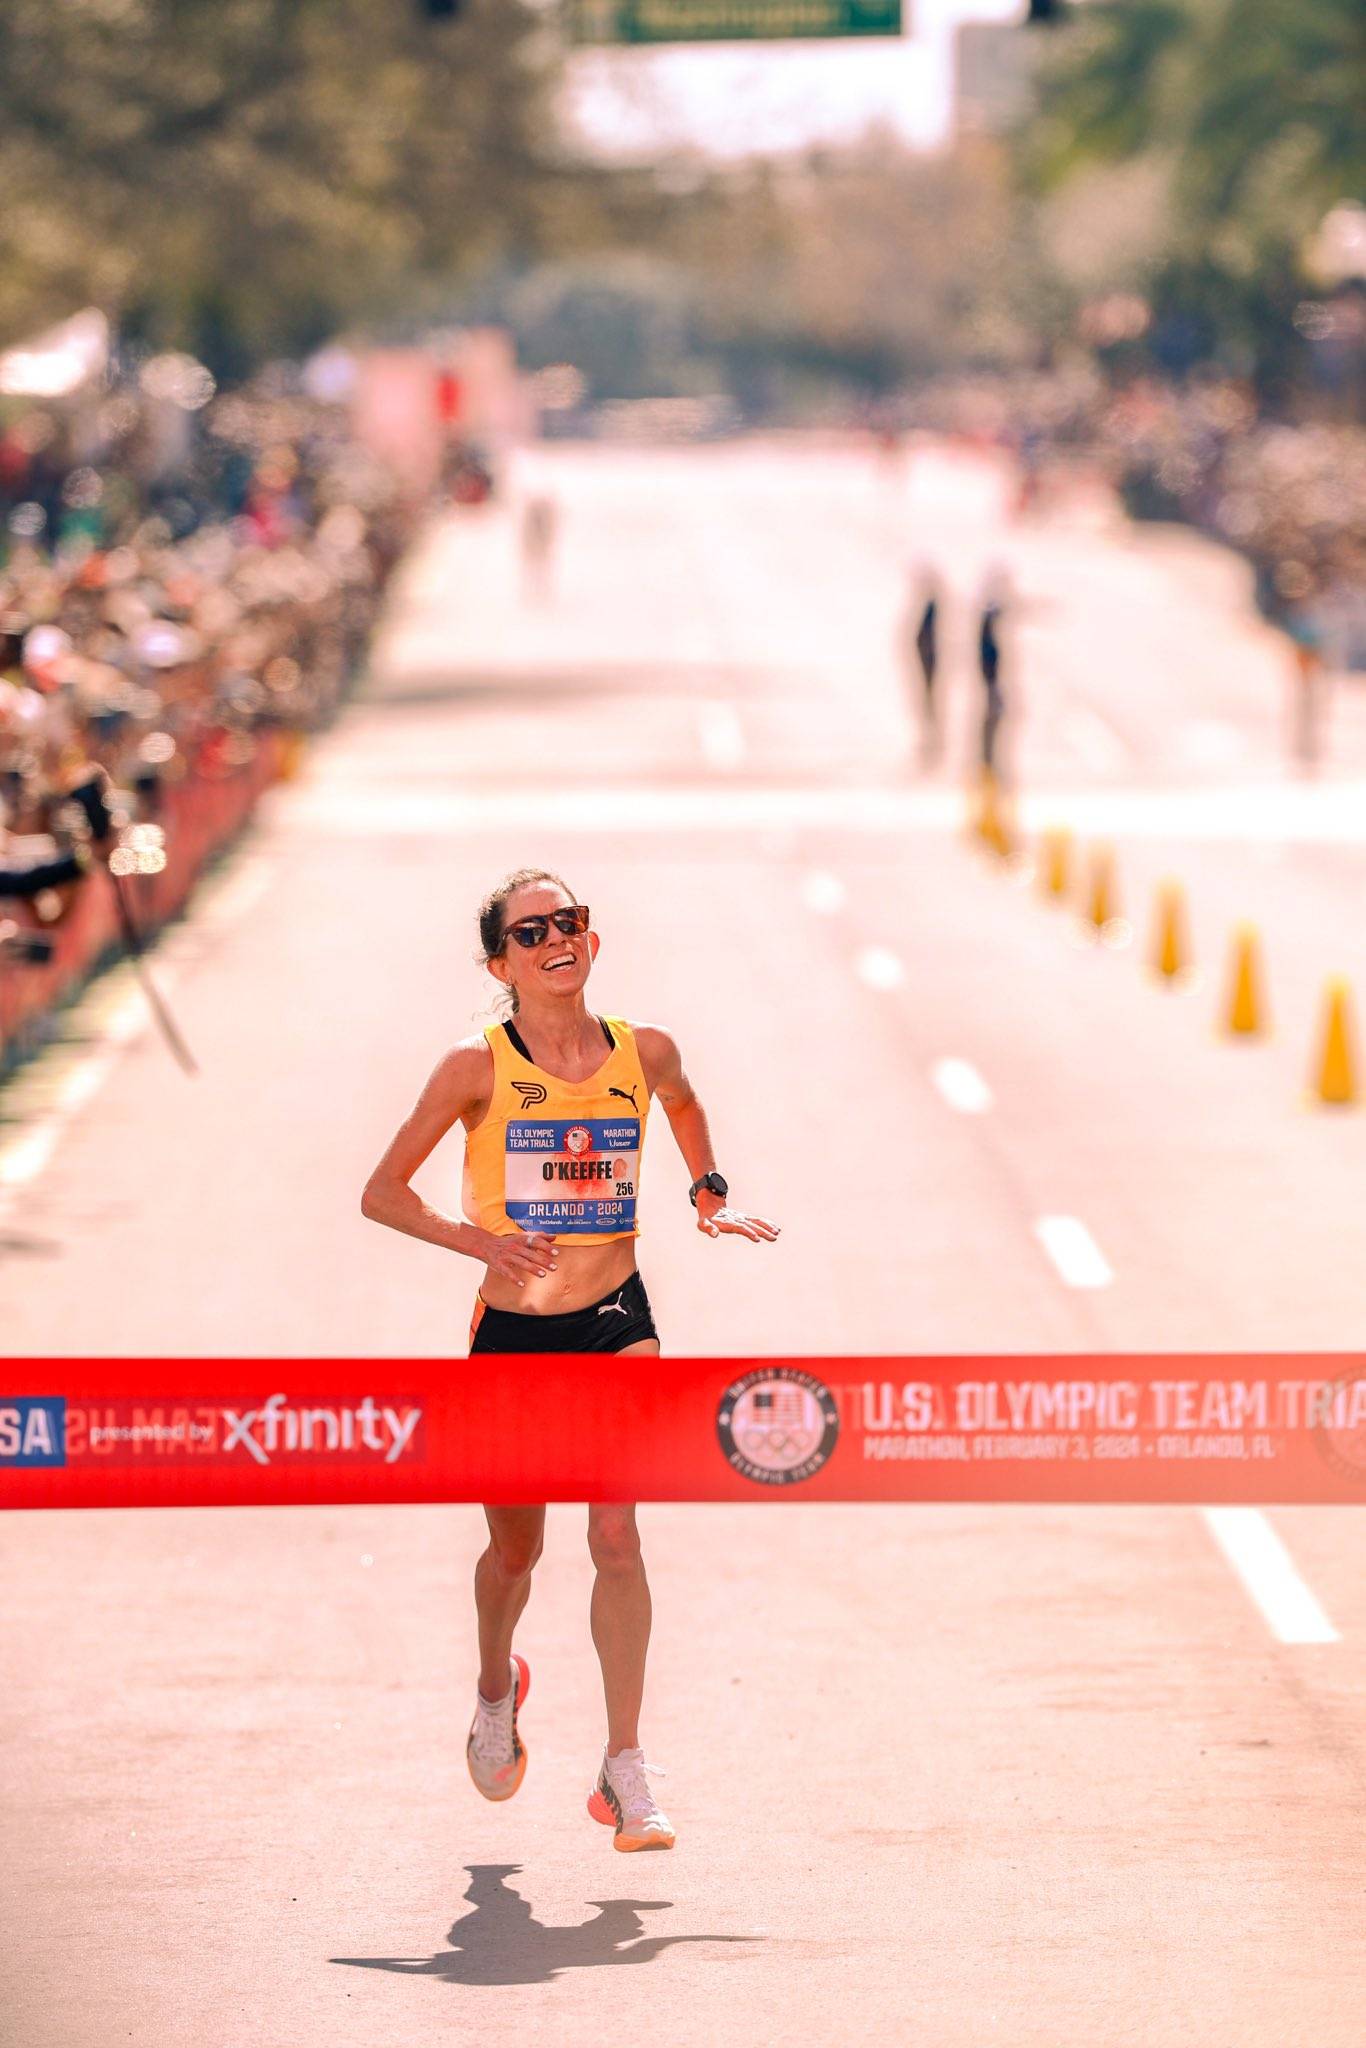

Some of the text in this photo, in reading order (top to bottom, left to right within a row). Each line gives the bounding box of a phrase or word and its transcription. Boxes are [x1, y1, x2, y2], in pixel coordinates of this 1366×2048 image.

[510, 1129, 554, 1138] U.S. OLYMPIC
[603, 1128, 637, 1138] MARATHON
[510, 1139, 555, 1148] TEAM TRIALS
[542, 1161, 612, 1181] O'KEEFFE
[616, 1182, 634, 1196] 256
[528, 1202, 623, 1217] ORLANDO 2024
[862, 1381, 946, 1431] U.S.
[956, 1381, 1139, 1431] OLYMPIC
[1150, 1380, 1269, 1430] TEAM
[90, 1421, 184, 1446] presented
[188, 1420, 215, 1445] by
[222, 1392, 422, 1465] xfinity
[973, 1435, 1069, 1460] FEBRUARY
[1092, 1434, 1140, 1460] 2024
